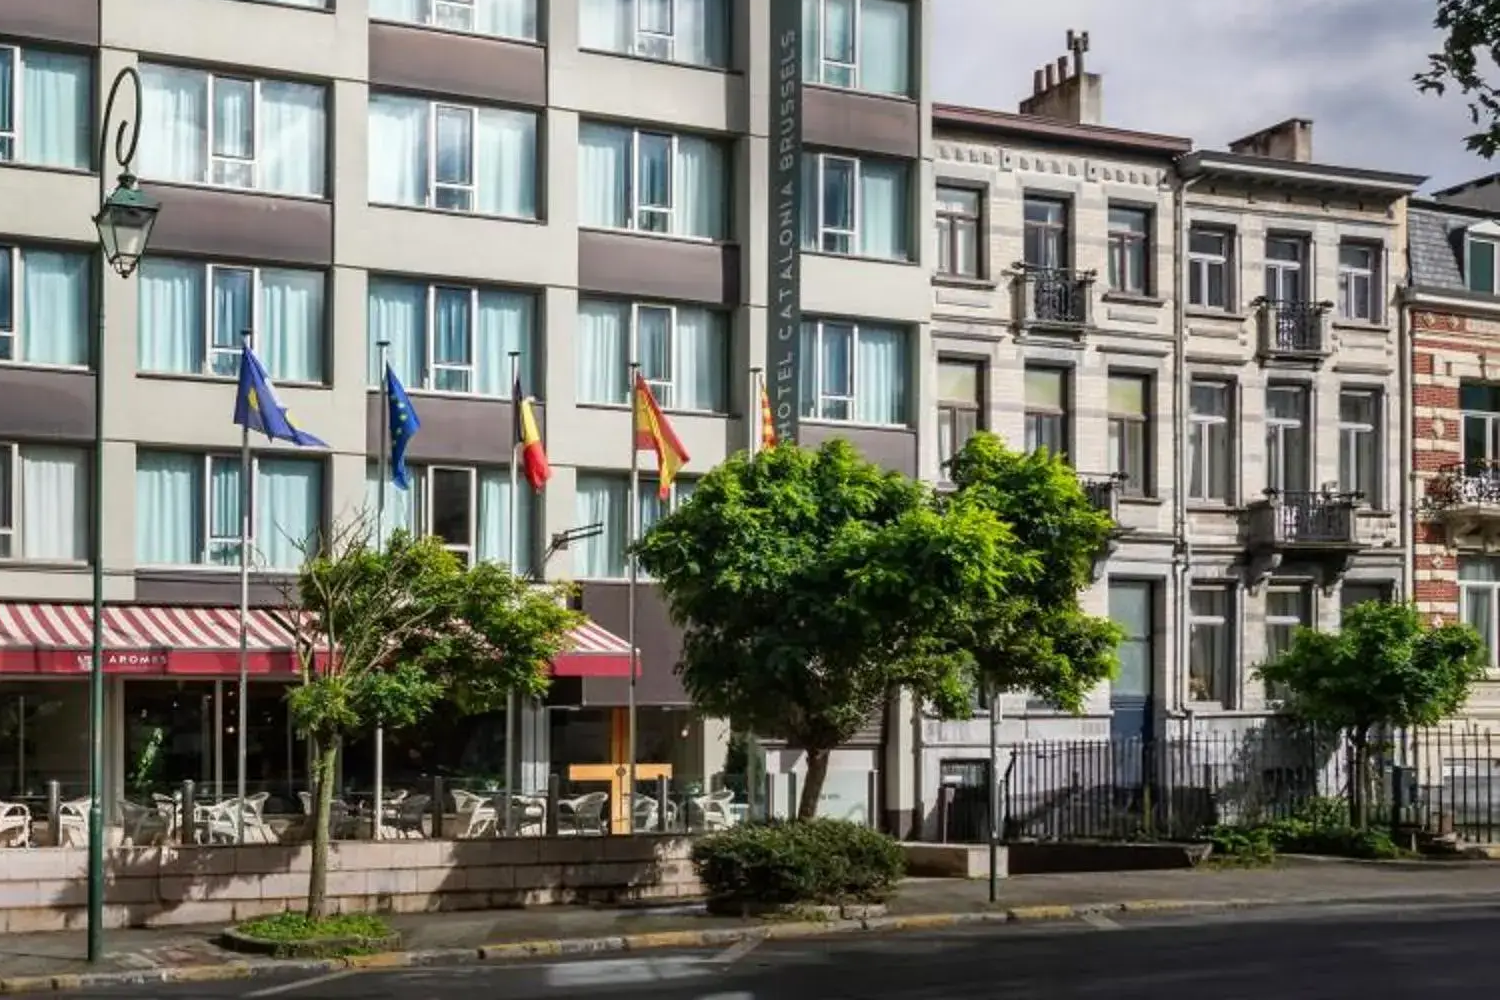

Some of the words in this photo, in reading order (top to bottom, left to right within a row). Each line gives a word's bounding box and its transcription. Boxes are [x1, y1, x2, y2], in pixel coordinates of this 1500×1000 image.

[779, 29, 795, 172] BRUSSELS
[778, 180, 793, 341] CATALONIA
[777, 350, 793, 440] HOTEL
